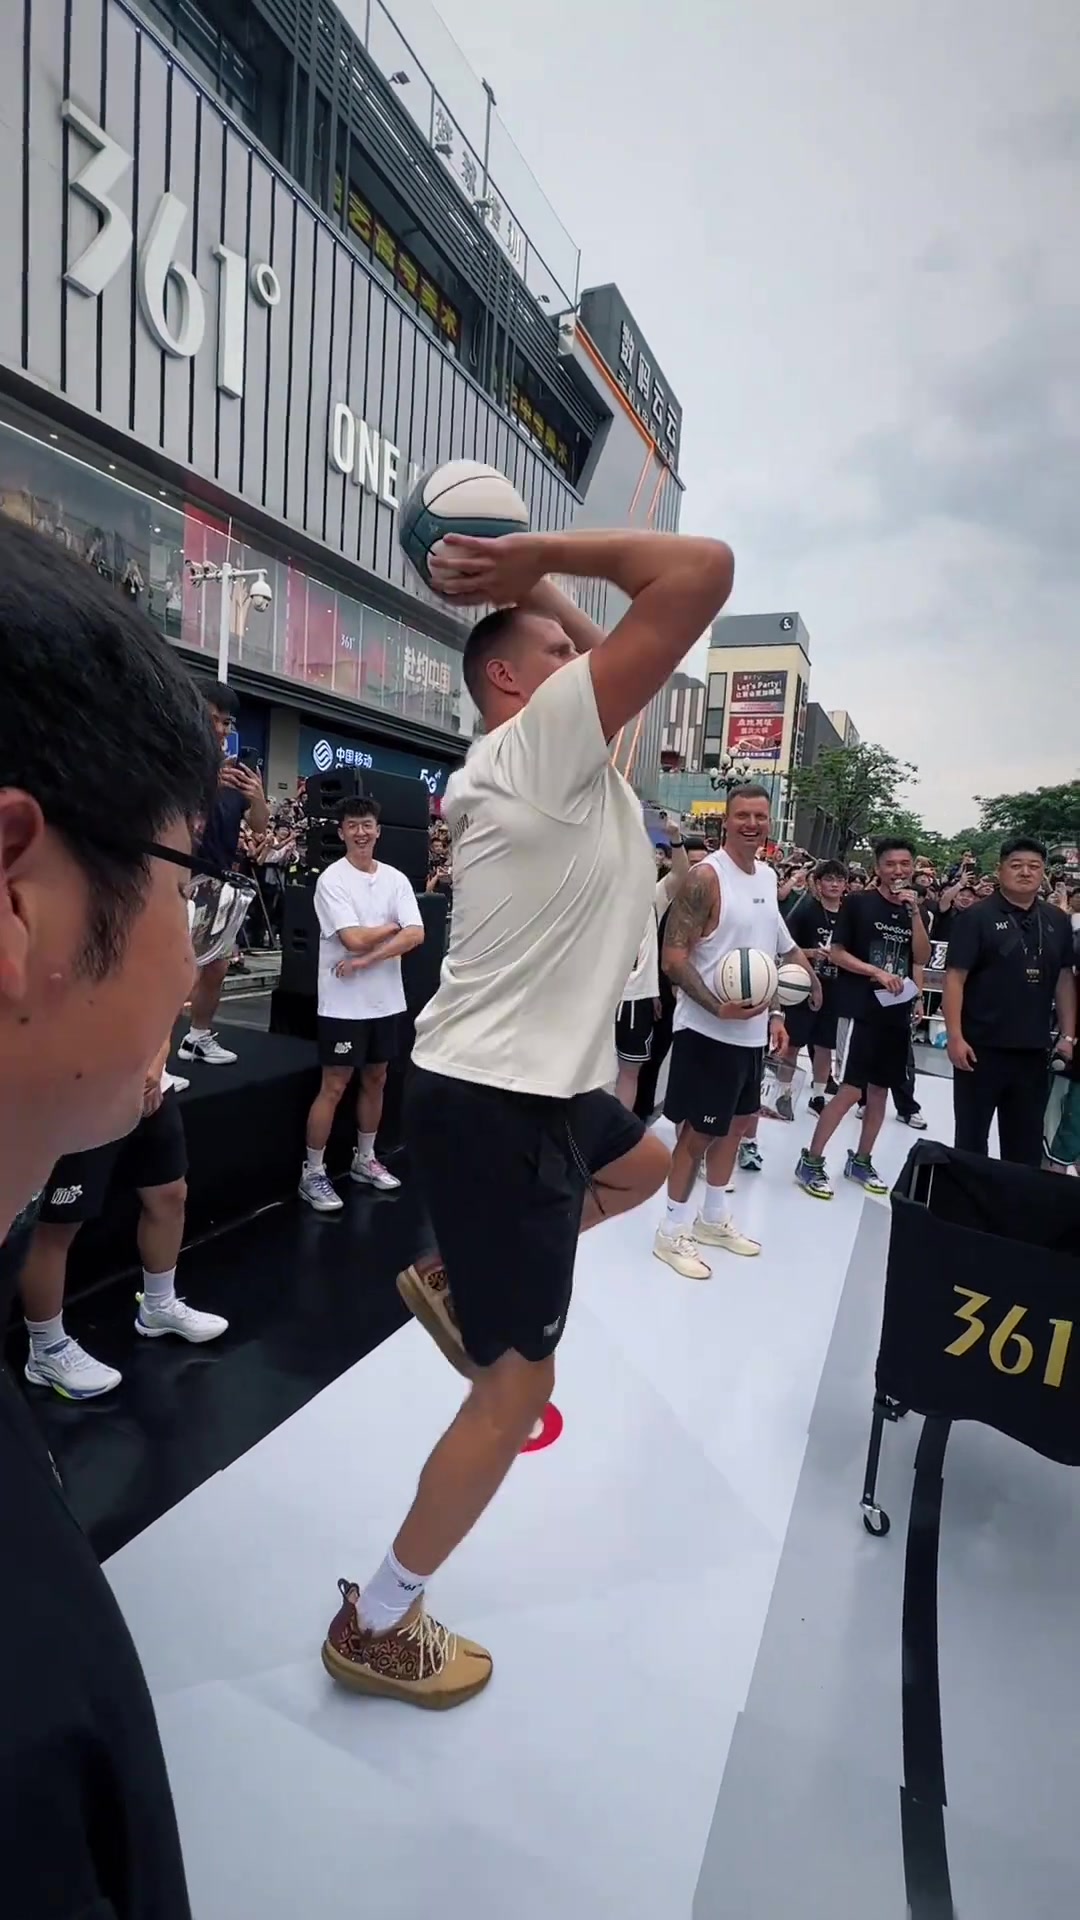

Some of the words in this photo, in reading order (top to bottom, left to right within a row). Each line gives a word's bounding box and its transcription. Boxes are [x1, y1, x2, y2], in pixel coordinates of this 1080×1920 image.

[61, 98, 281, 400] 361°
[329, 402, 401, 509] ONE
[403, 645, 450, 694] 赴约中国
[737, 682, 756, 691] Let's
[757, 680, 782, 690] Party!
[335, 746, 373, 769] 中国移动
[943, 1284, 1074, 1388] 361
